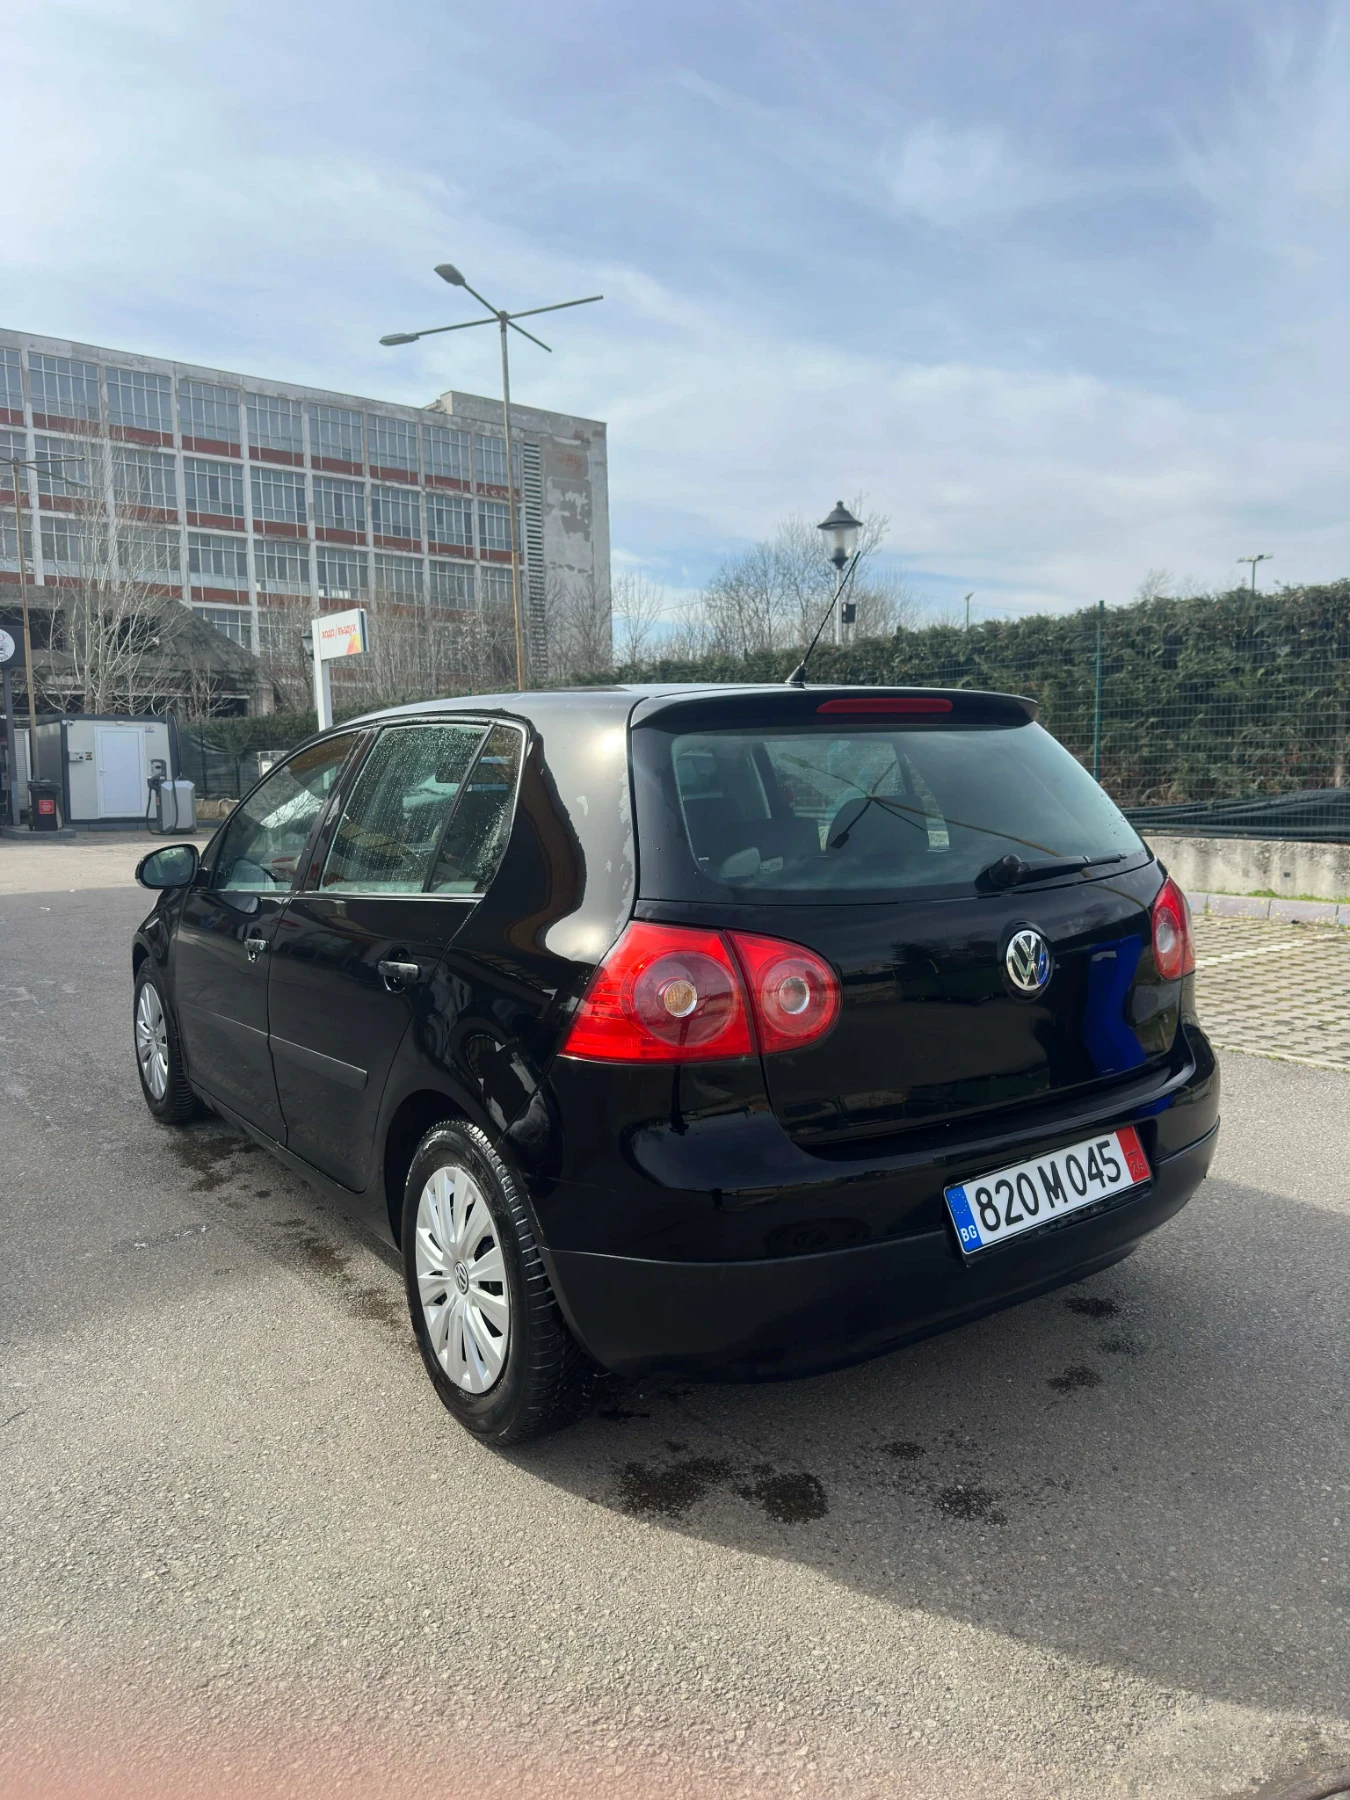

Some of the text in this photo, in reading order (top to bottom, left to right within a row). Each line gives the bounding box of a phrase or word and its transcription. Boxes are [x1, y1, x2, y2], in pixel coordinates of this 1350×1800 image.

[975, 1139, 1121, 1232] 820 M 045
[960, 1224, 978, 1243] BG
